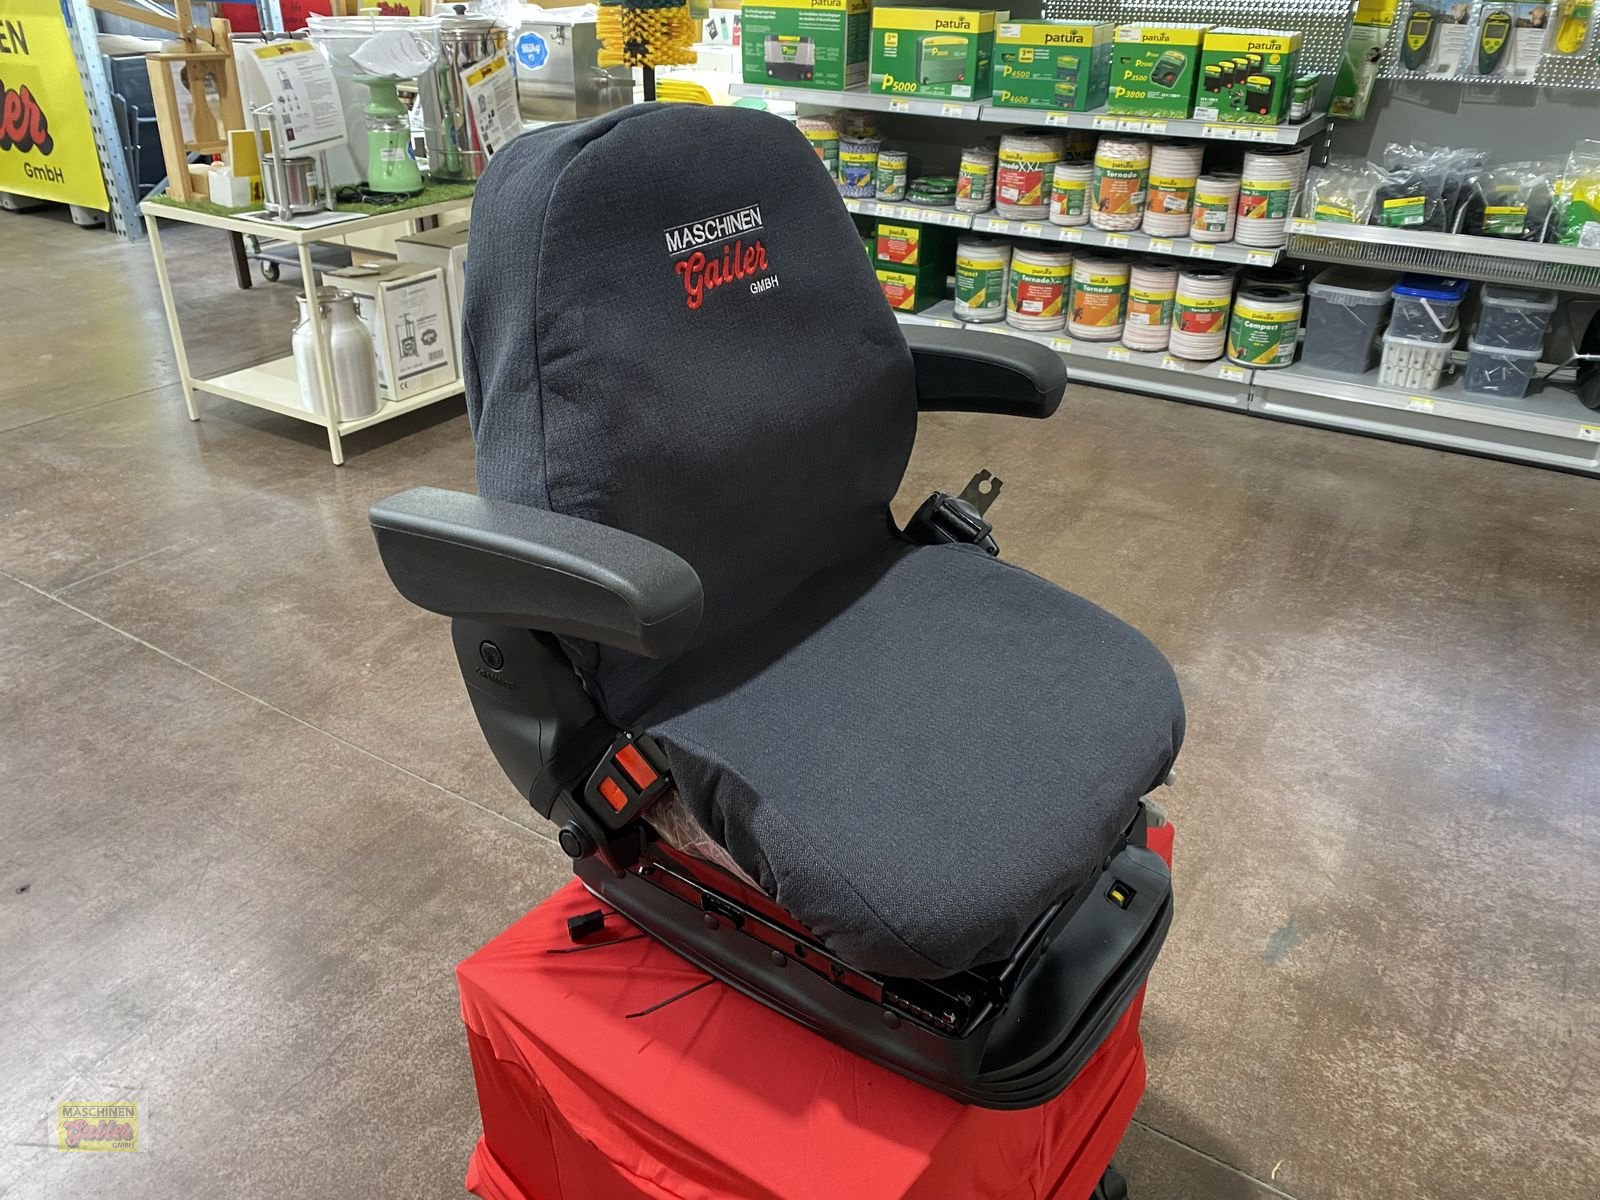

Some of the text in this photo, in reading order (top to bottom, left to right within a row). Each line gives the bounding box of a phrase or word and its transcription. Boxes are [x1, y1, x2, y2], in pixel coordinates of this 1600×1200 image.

[935, 19, 970, 30] patura
[1045, 32, 1084, 44] patura
[1142, 34, 1169, 42] patura
[1248, 41, 1281, 50] patura
[882, 72, 917, 92] P5000
[1115, 85, 1146, 98] P3800
[0, 79, 53, 155] er
[24, 162, 64, 184] GmbH
[1018, 161, 1043, 173] XXL
[1106, 170, 1137, 178] Tornado
[665, 207, 762, 252] MASCHINEN
[674, 240, 768, 310] Gailer
[1022, 274, 1050, 284] Tornado
[749, 275, 779, 294] GMBH
[1083, 284, 1113, 293] Tornado
[1244, 321, 1279, 331] Compact
